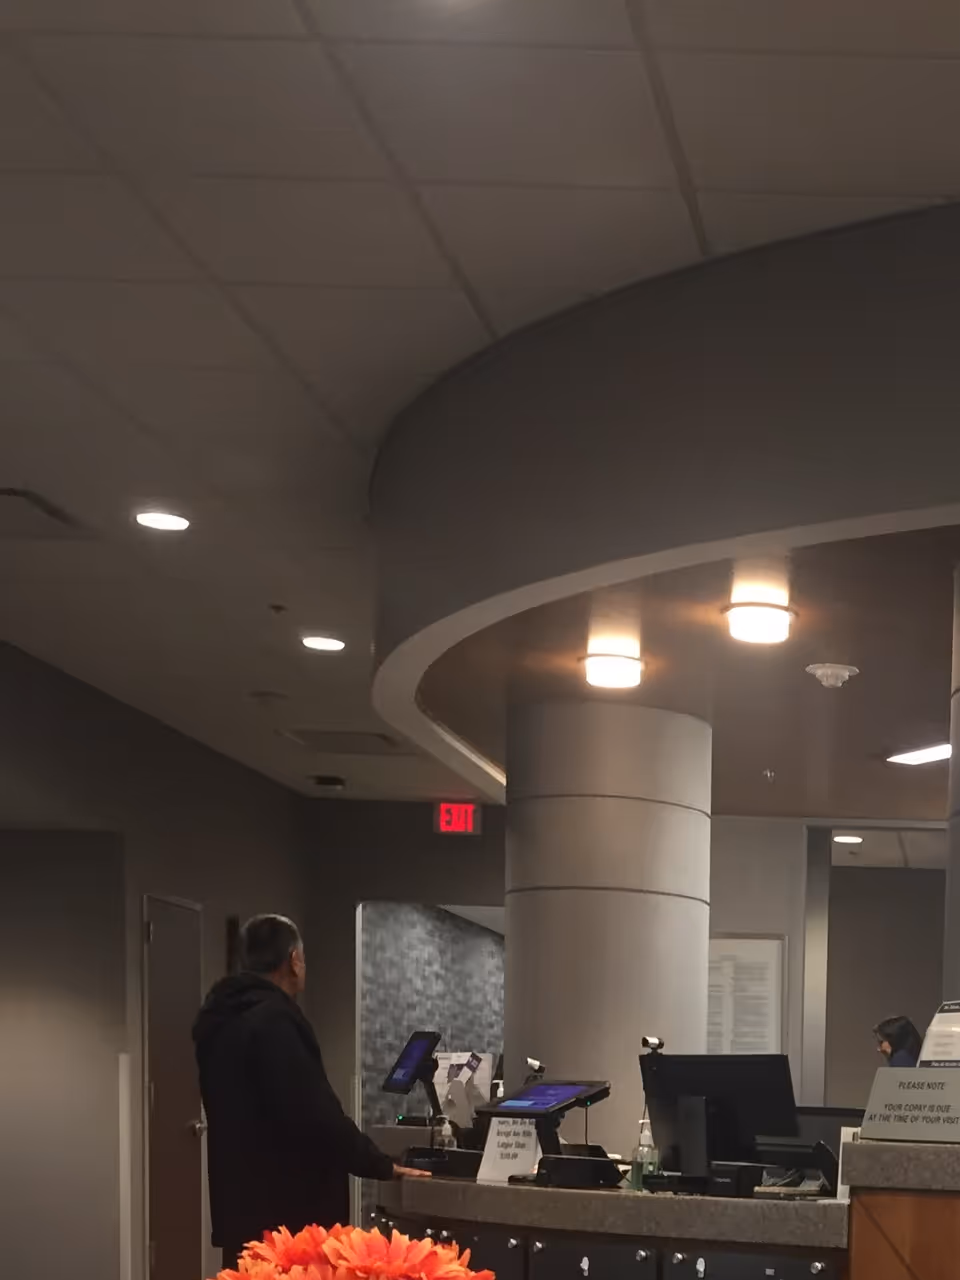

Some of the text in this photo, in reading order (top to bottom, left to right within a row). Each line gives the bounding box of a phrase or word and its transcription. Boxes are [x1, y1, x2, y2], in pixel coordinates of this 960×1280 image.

[440, 803, 475, 832] EXIT
[898, 1081, 946, 1090] PLEASE NOTE
[885, 1103, 951, 1113] YOUR COPAY IS DUE
[879, 1115, 891, 1123] THE
[893, 1115, 909, 1123] TIME
[922, 1116, 941, 1124] YOUR
[943, 1116, 960, 1124] VISIT
